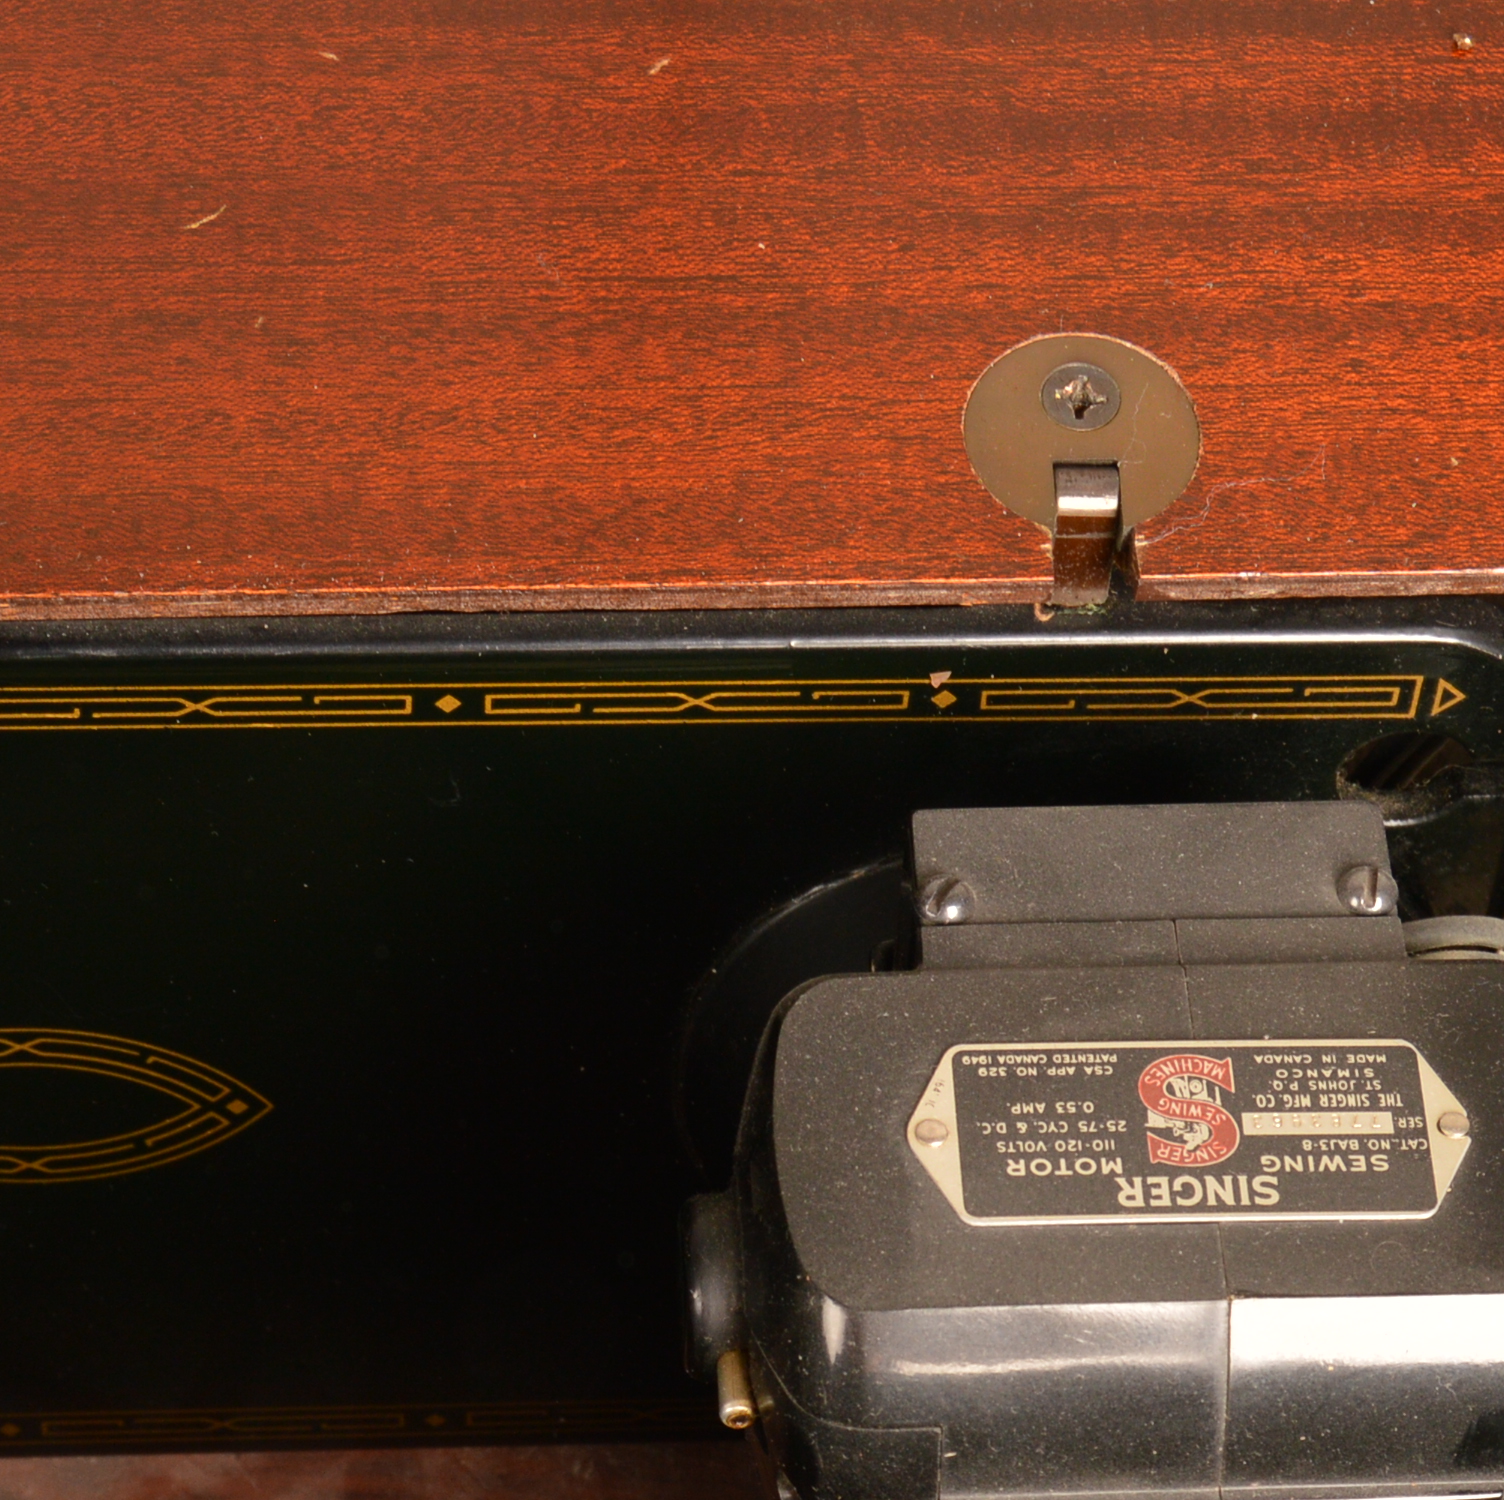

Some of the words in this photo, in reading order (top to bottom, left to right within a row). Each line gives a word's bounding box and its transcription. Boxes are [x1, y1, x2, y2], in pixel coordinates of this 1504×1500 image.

[962, 1055, 991, 1065] 1949
[997, 1054, 1047, 1064] CANADA
[1053, 1054, 1117, 1064] PATENTED
[1254, 1054, 1312, 1064] CANADA
[1322, 1054, 1336, 1063] IN
[1346, 1054, 1386, 1063] MADE
[978, 1067, 1007, 1076] 329
[1014, 1066, 1037, 1076] NO.
[1043, 1066, 1076, 1075] APP.
[1084, 1066, 1113, 1075] CSA
[1144, 1058, 1225, 1086] MACHINES
[1275, 1068, 1374, 1078] SIMANCO
[1309, 1080, 1356, 1090] JOHNS
[1360, 1080, 1381, 1090] ST.
[1252, 1094, 1274, 1107] CO.
[1279, 1094, 1310, 1107] MFG.
[1319, 1093, 1369, 1107] SINGER
[1378, 1093, 1403, 1107] THE
[1007, 1102, 1046, 1113] AMP.
[1055, 1101, 1094, 1113] 0.53
[1157, 1097, 1226, 1127] SEWING
[1034, 1121, 1068, 1133] CYC.
[1079, 1120, 1127, 1132] 25-75
[1394, 1116, 1423, 1127] SER.
[1017, 1122, 1027, 1133] &
[996, 1140, 1047, 1152] VOLTS
[1054, 1139, 1115, 1151] 110-120
[1302, 1139, 1359, 1150] BAJ3-8
[1364, 1139, 1391, 1150] NO.
[1157, 1141, 1227, 1163] SINGER
[1006, 1157, 1122, 1176] MOTOR
[1260, 1153, 1389, 1172] SEWING
[1115, 1175, 1279, 1206] SINGER
